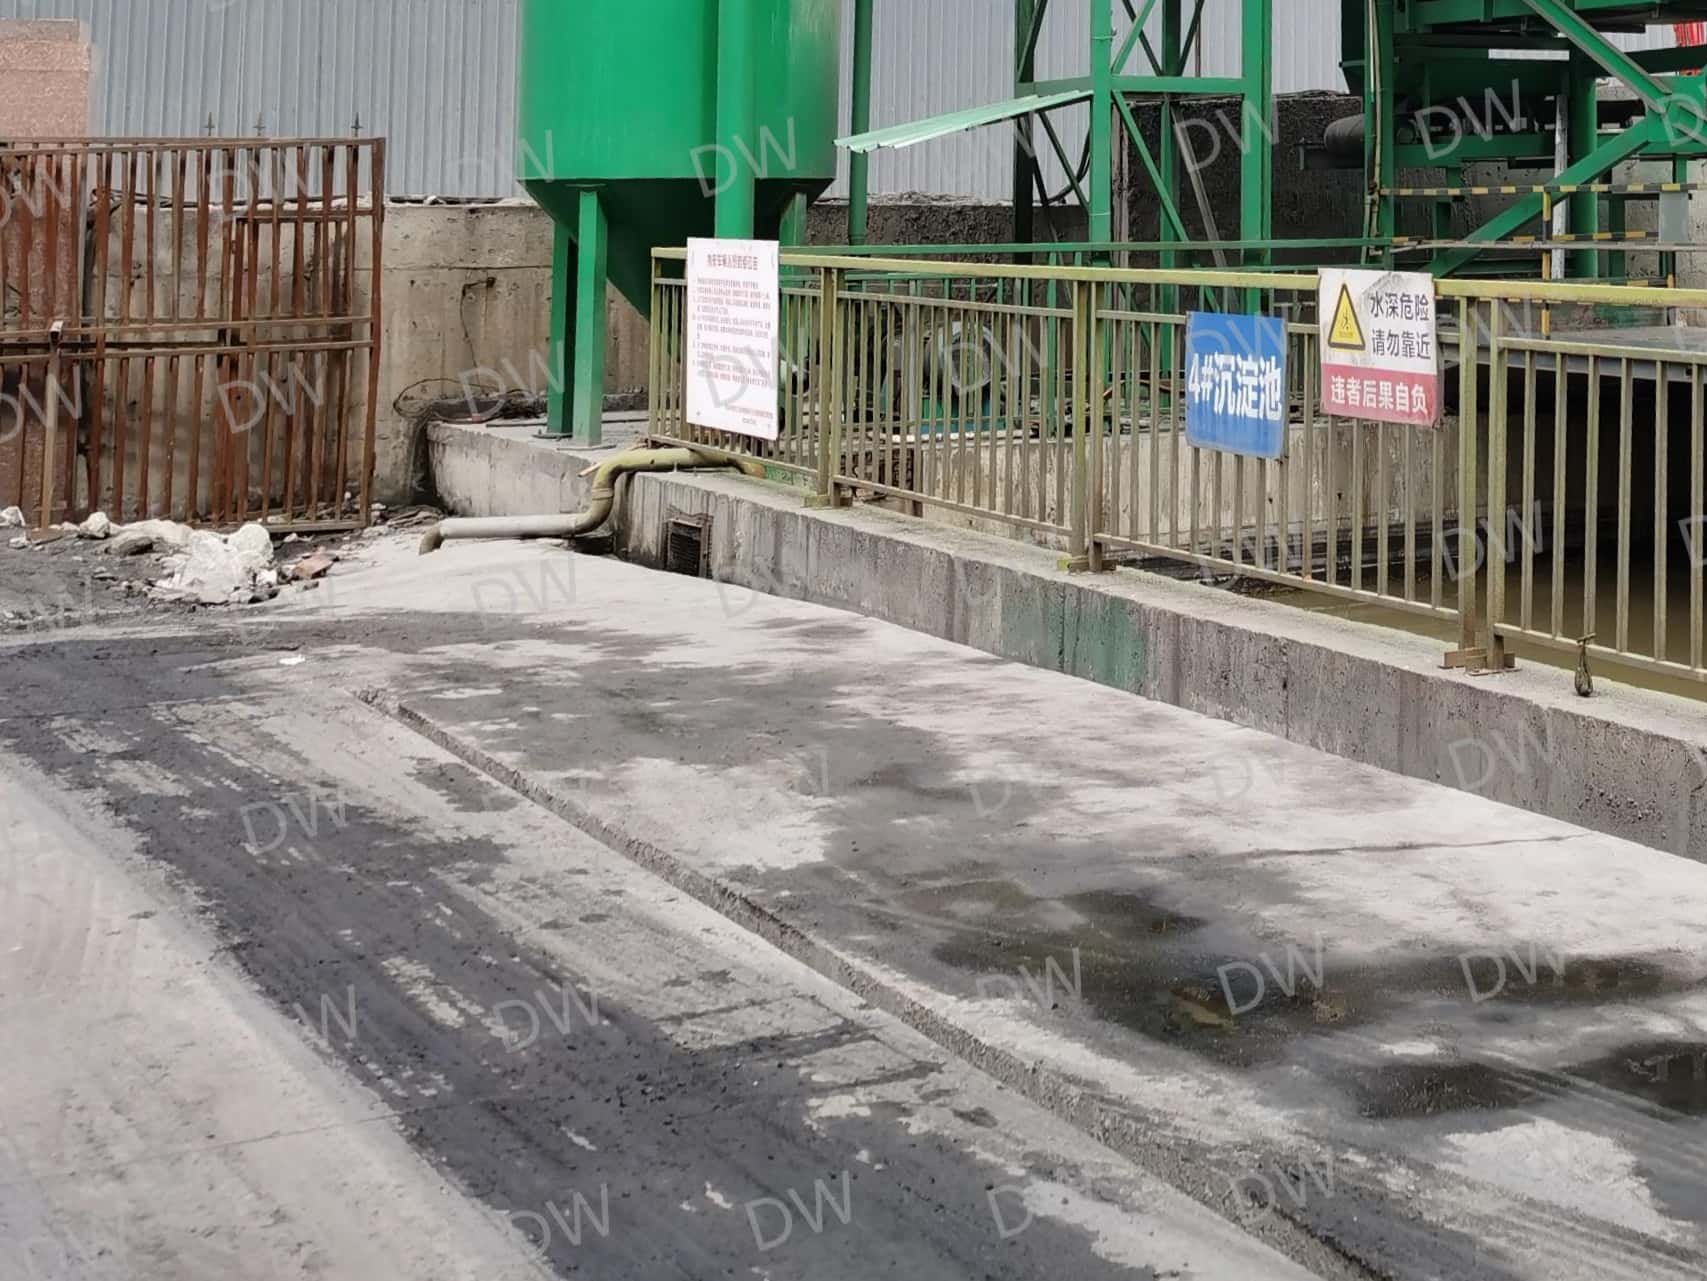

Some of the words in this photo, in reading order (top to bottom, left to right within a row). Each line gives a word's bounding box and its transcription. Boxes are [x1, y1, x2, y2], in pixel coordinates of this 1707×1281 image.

[1370, 292, 1430, 322] 水深危险
[1371, 328, 1432, 361] 请勿靠近
[1187, 351, 1282, 422] 4#沉淀池
[1330, 375, 1429, 416] 违者后果自负
